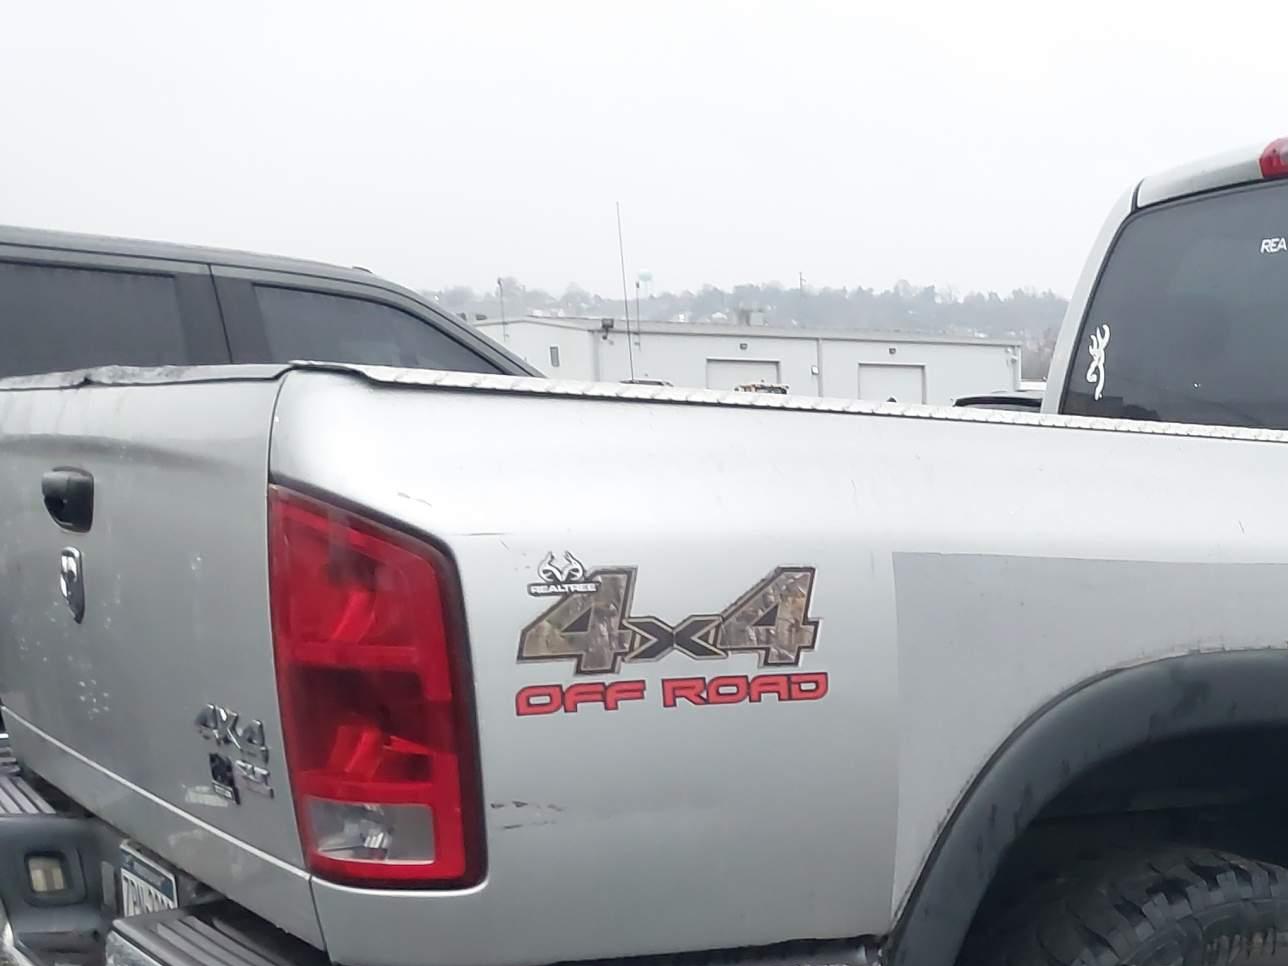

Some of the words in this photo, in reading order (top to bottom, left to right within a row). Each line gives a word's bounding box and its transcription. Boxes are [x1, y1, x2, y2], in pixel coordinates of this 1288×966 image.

[530, 582, 599, 595] REALTREE
[515, 680, 646, 716] OFF
[661, 672, 829, 708] ROAD
